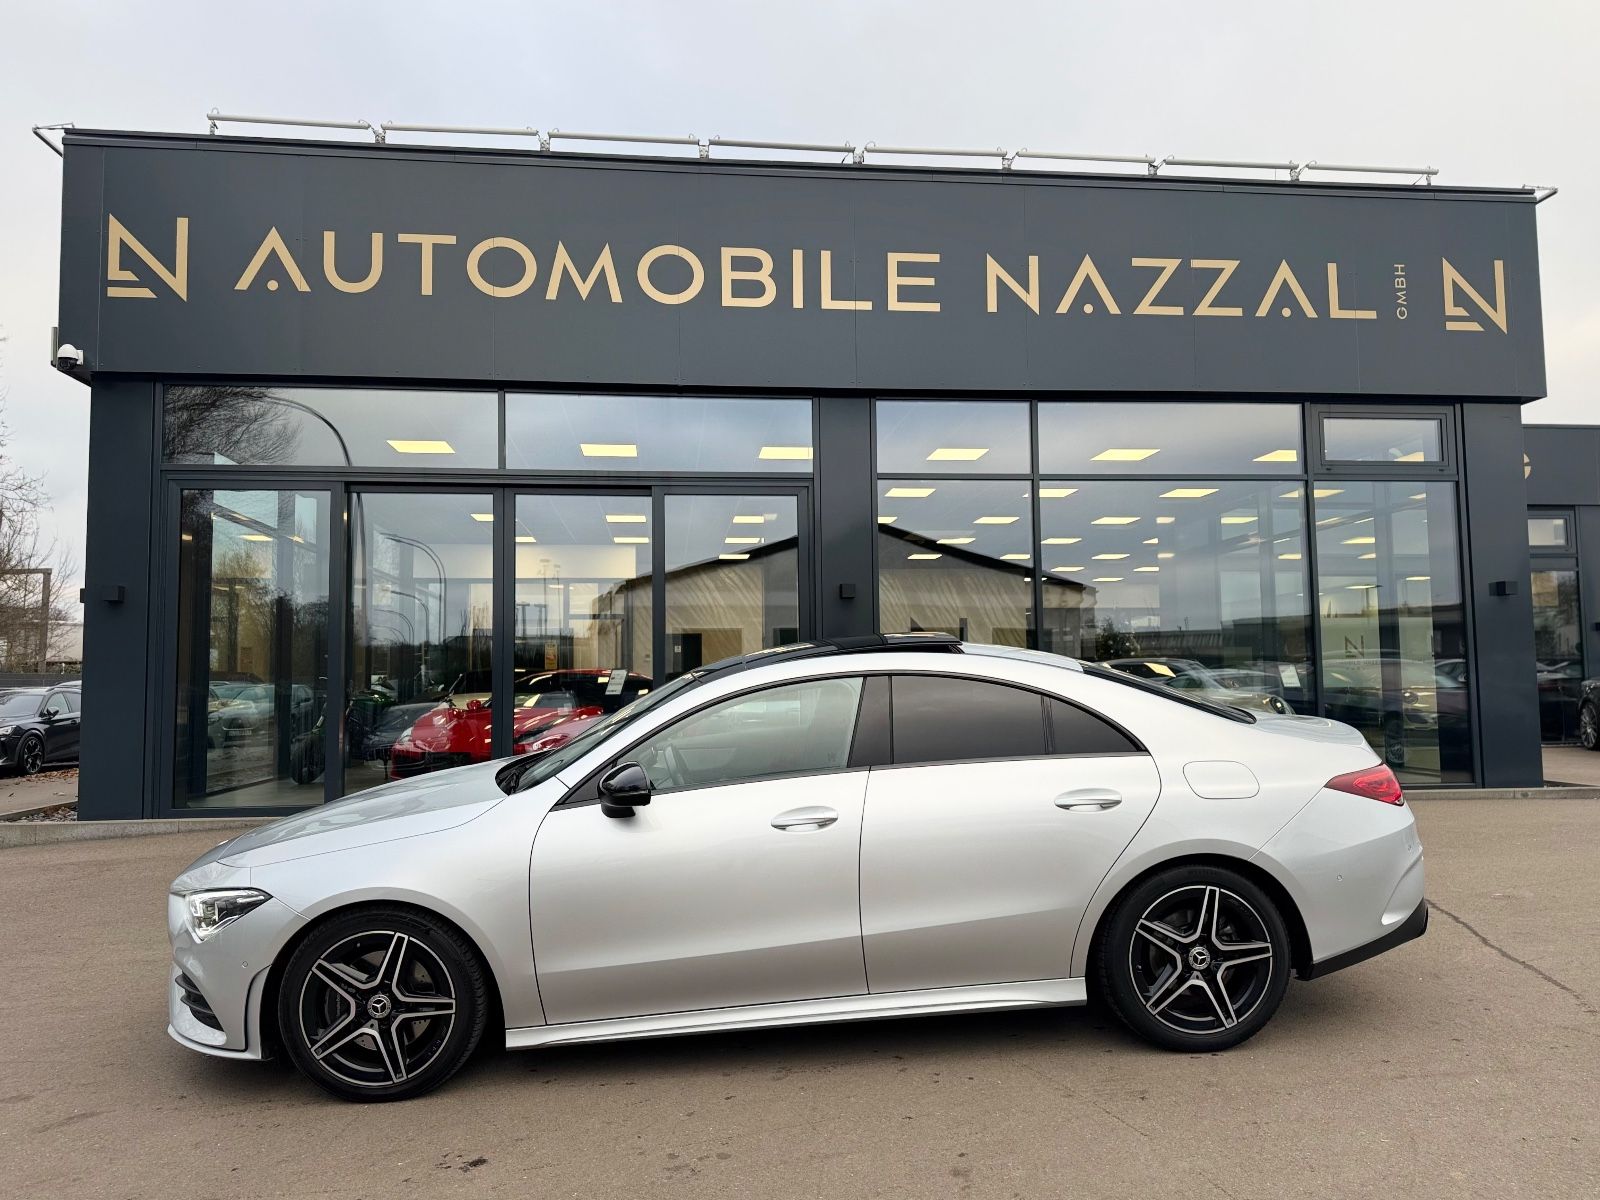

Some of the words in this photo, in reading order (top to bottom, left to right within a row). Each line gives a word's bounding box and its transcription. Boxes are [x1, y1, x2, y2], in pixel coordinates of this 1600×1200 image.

[235, 226, 941, 313] AUTOMOBILE
[986, 254, 1377, 320] NAZZAL
[1393, 263, 1408, 320] GMBH
